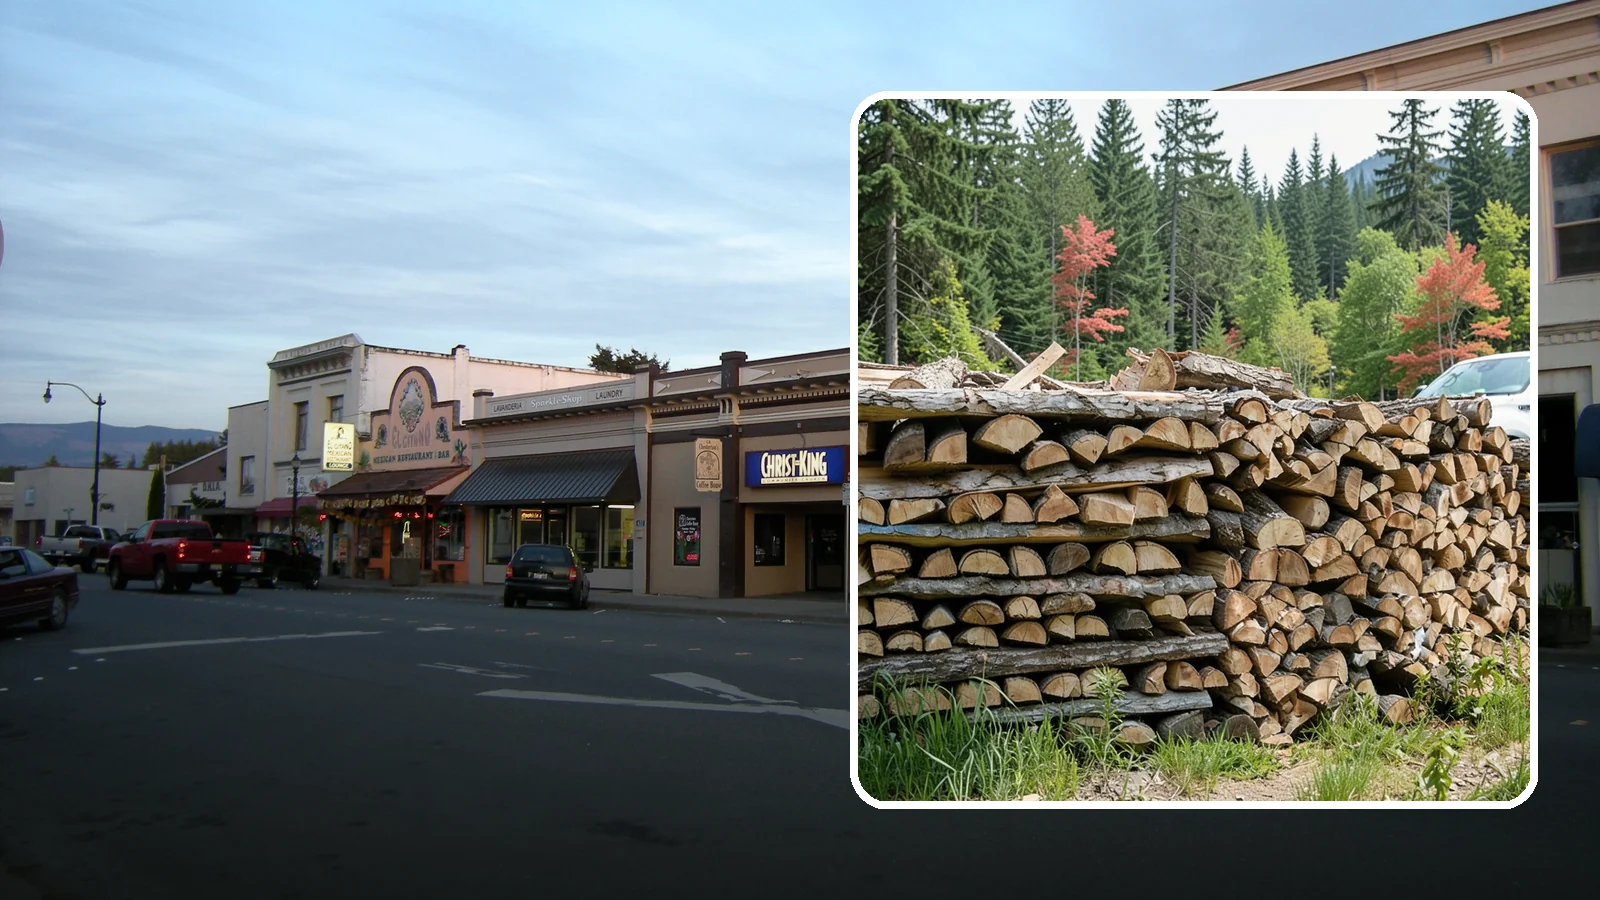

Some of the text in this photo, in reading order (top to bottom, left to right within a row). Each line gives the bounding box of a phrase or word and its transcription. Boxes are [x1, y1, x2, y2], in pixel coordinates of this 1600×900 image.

[595, 389, 623, 400] LAUNDRY
[493, 402, 522, 412] LAVANDERIA
[530, 395, 583, 409] Sparkle Shop
[373, 455, 396, 464] MEXICAN
[397, 452, 434, 462] RESTAURANT
[438, 450, 450, 459] BAR
[761, 450, 827, 478] CHRIST KING
[696, 481, 722, 489] Coffee House
